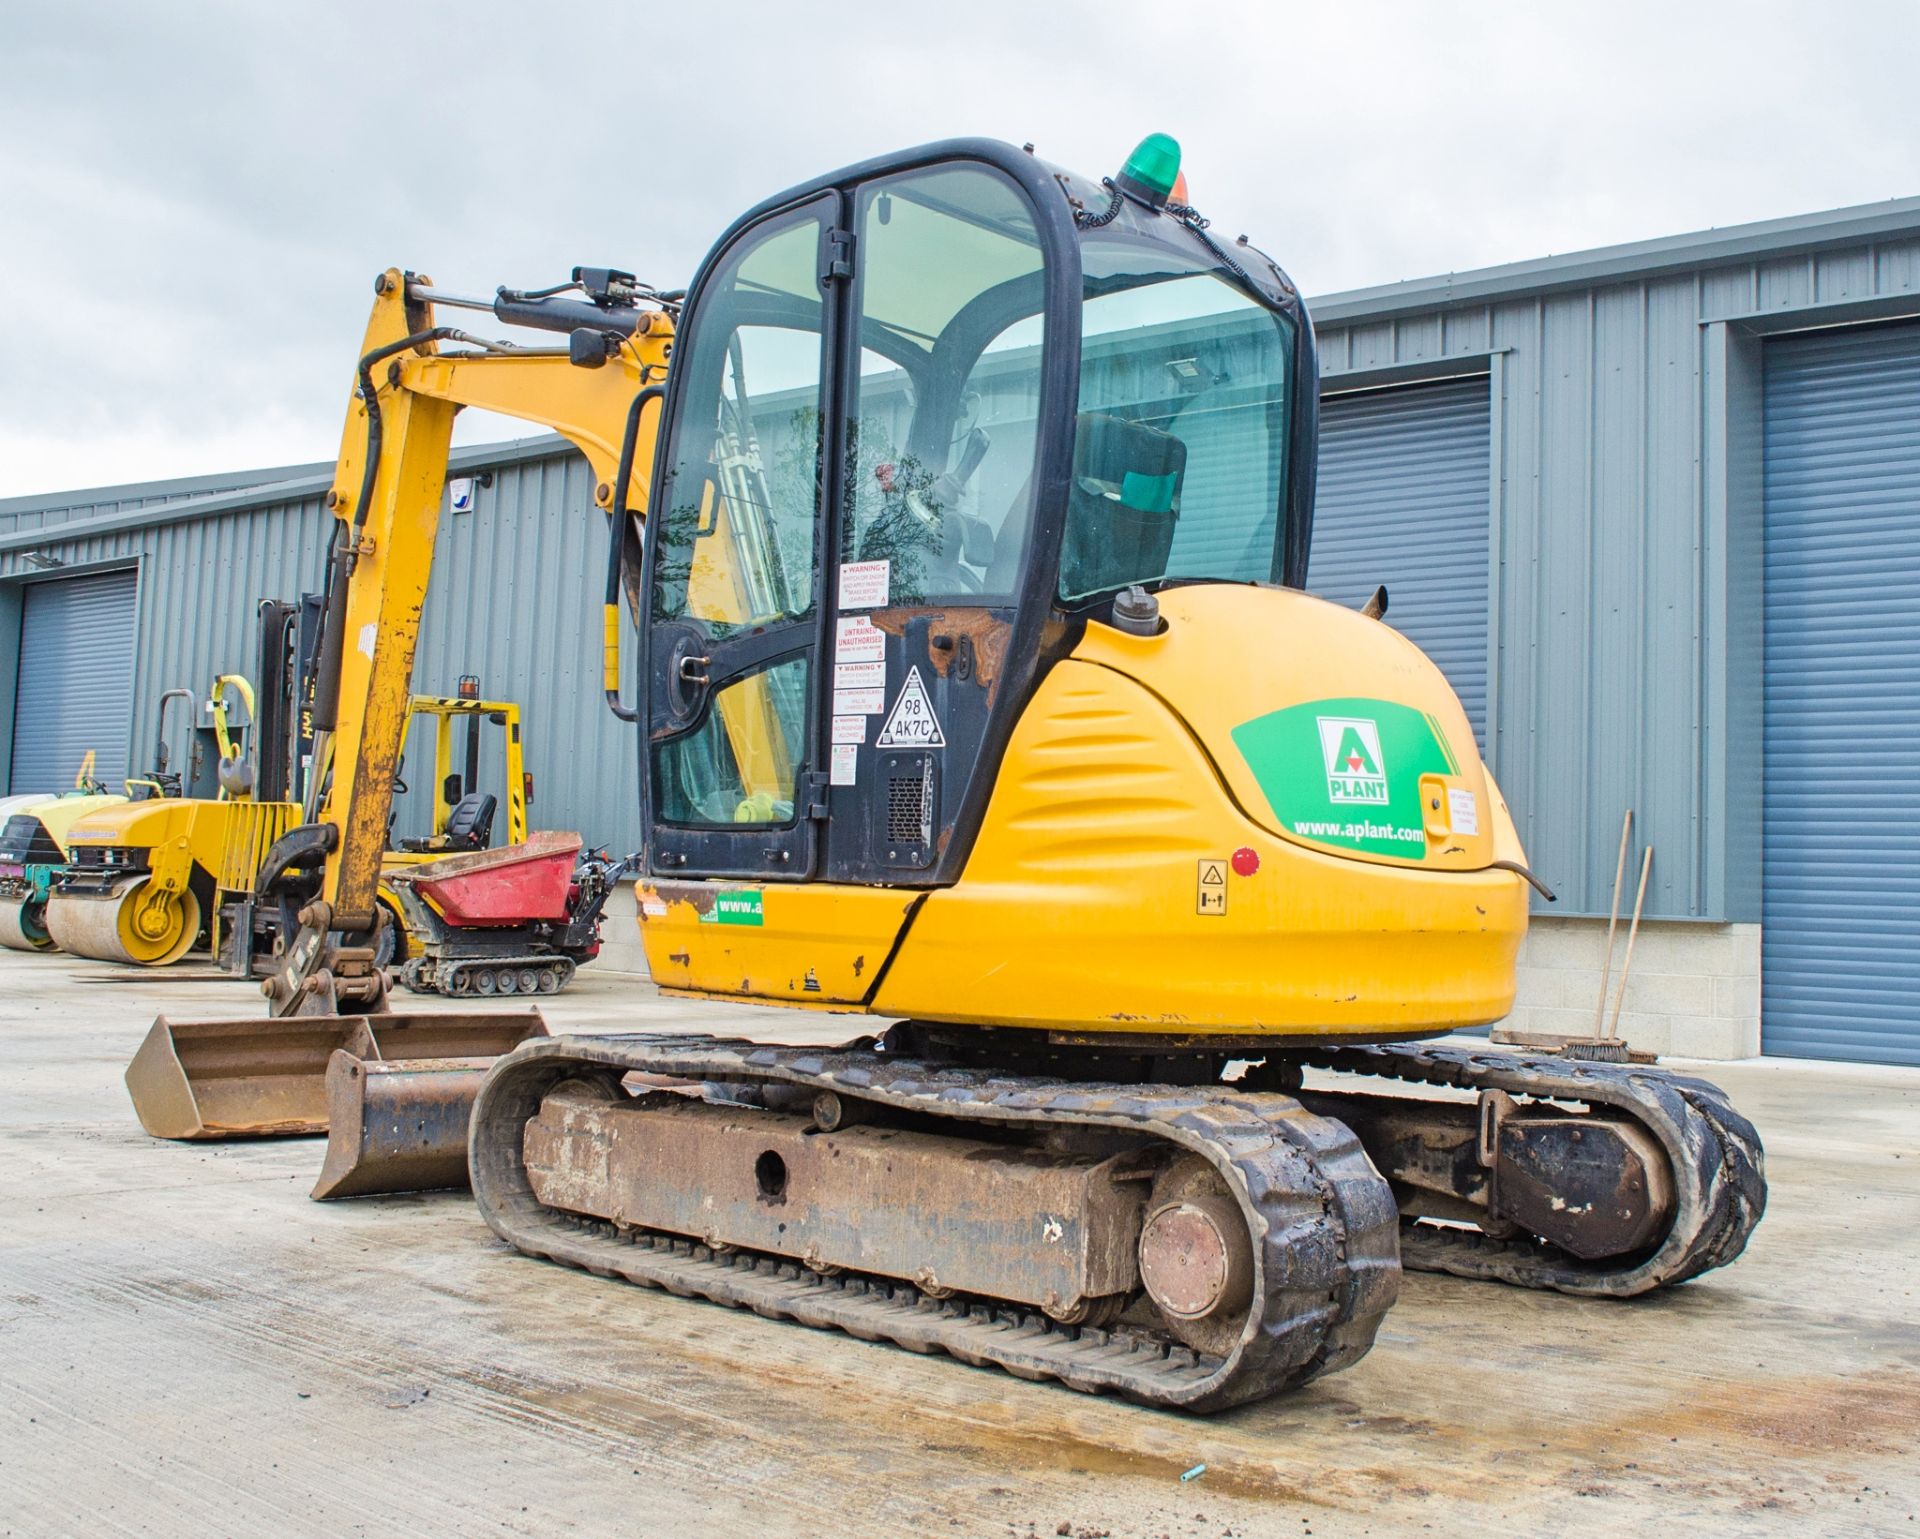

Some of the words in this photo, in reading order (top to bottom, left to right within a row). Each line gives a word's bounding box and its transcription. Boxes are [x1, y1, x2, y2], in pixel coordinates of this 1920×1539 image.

[848, 564, 880, 573] WARNING
[856, 618, 865, 626] NO
[844, 627, 877, 636] UNTRAINED
[838, 636, 882, 646] UNAUTHORISED
[905, 699, 920, 715] 98
[895, 720, 929, 736] AK7C
[1334, 727, 1380, 775] A
[1330, 780, 1385, 800] PLANT
[1294, 820, 1424, 842] www.aplant.com
[720, 900, 763, 914] www.a
